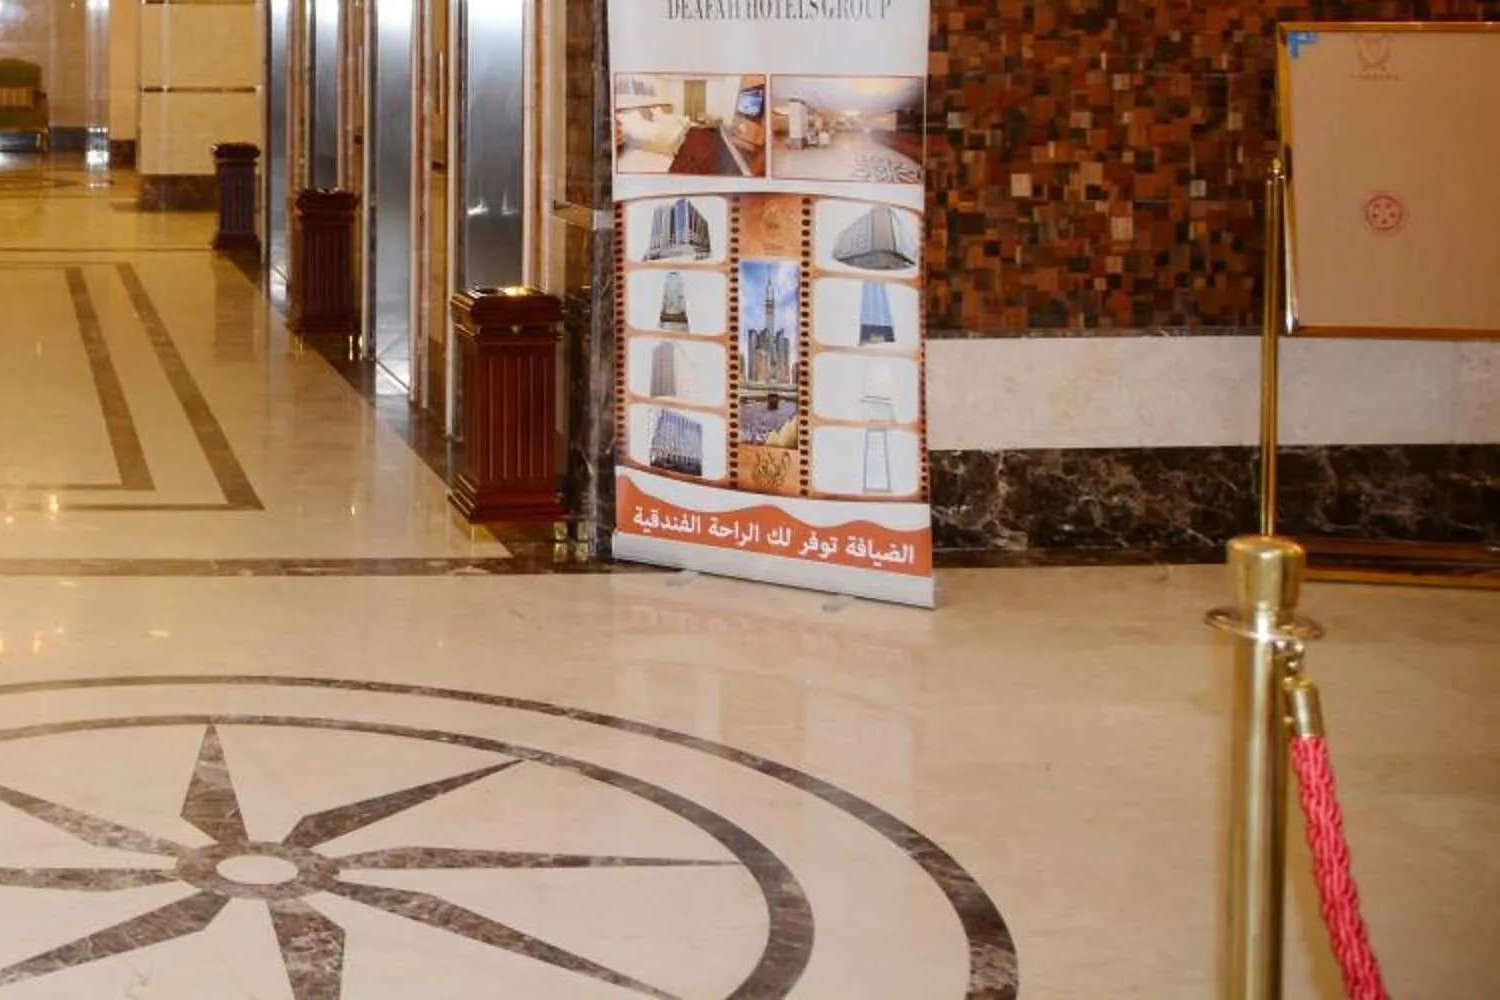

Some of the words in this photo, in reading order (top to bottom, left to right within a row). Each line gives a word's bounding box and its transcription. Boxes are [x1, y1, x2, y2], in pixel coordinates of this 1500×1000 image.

[632, 505, 701, 535] الفندقية
[707, 517, 760, 548] الراحة
[766, 526, 792, 547] لك
[798, 530, 838, 559] توفر
[844, 535, 916, 568] الضيافة
